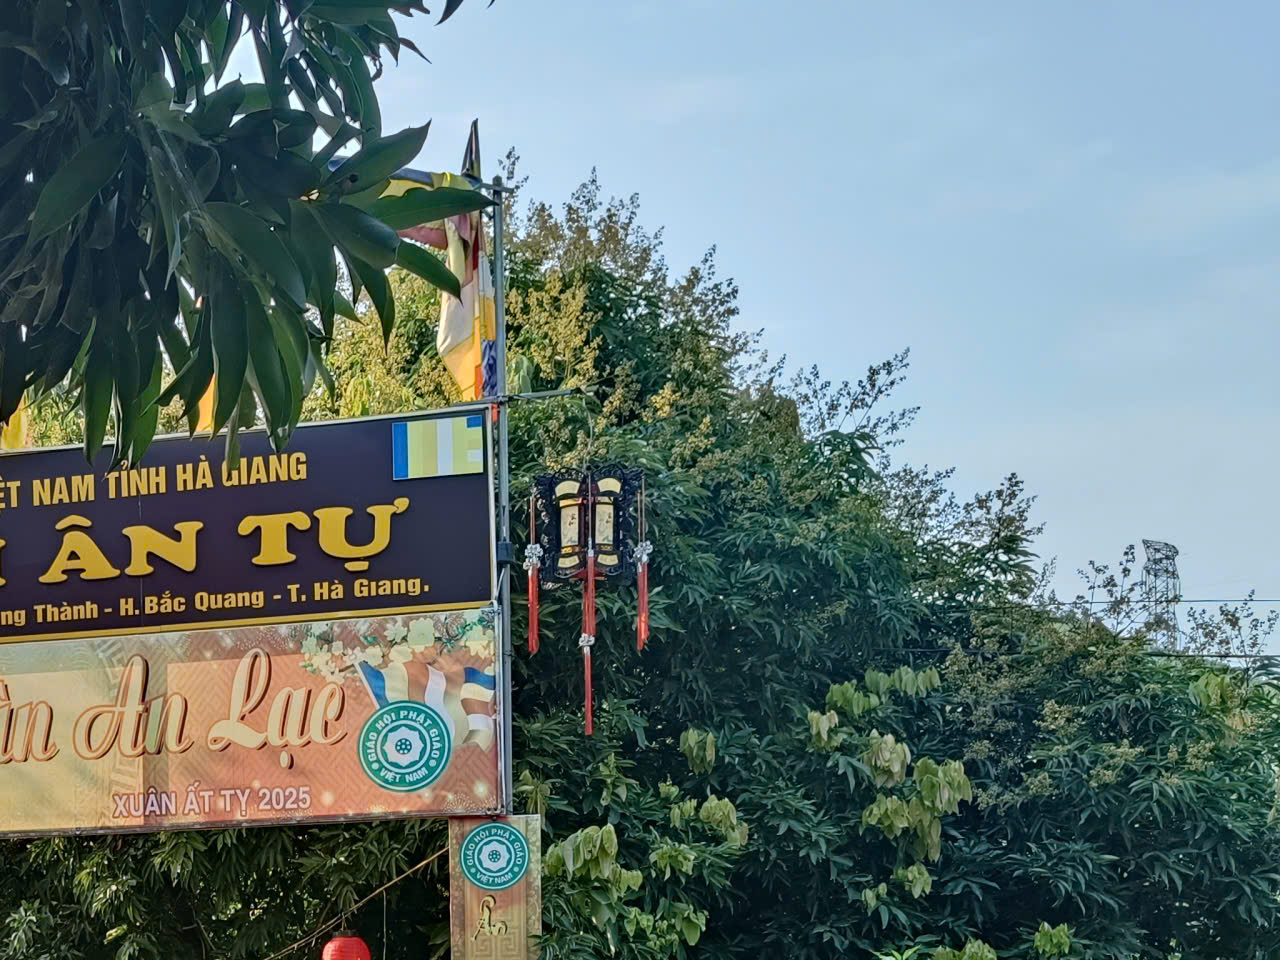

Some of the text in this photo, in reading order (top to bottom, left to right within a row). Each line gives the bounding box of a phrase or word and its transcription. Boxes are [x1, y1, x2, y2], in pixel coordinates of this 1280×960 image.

[32, 474, 95, 506] NAM
[105, 460, 166, 499] TỈNH
[176, 455, 214, 492] HÀ
[38, 514, 204, 584] ÂN
[237, 497, 410, 572] TỰ
[34, 602, 98, 624] Thành
[120, 598, 139, 616] H.
[144, 590, 186, 614] Bắc
[194, 587, 265, 613] Quang
[287, 584, 307, 603] T.
[314, 579, 345, 600] Hà
[73, 654, 195, 761] An
[207, 646, 349, 770] Lạc
[365, 731, 377, 761] GIÁO
[429, 728, 442, 758] GIÁO
[405, 766, 428, 783] NAM
[113, 786, 177, 818] XUÂN
[182, 781, 214, 815] ẤT
[259, 785, 311, 811] 2025
